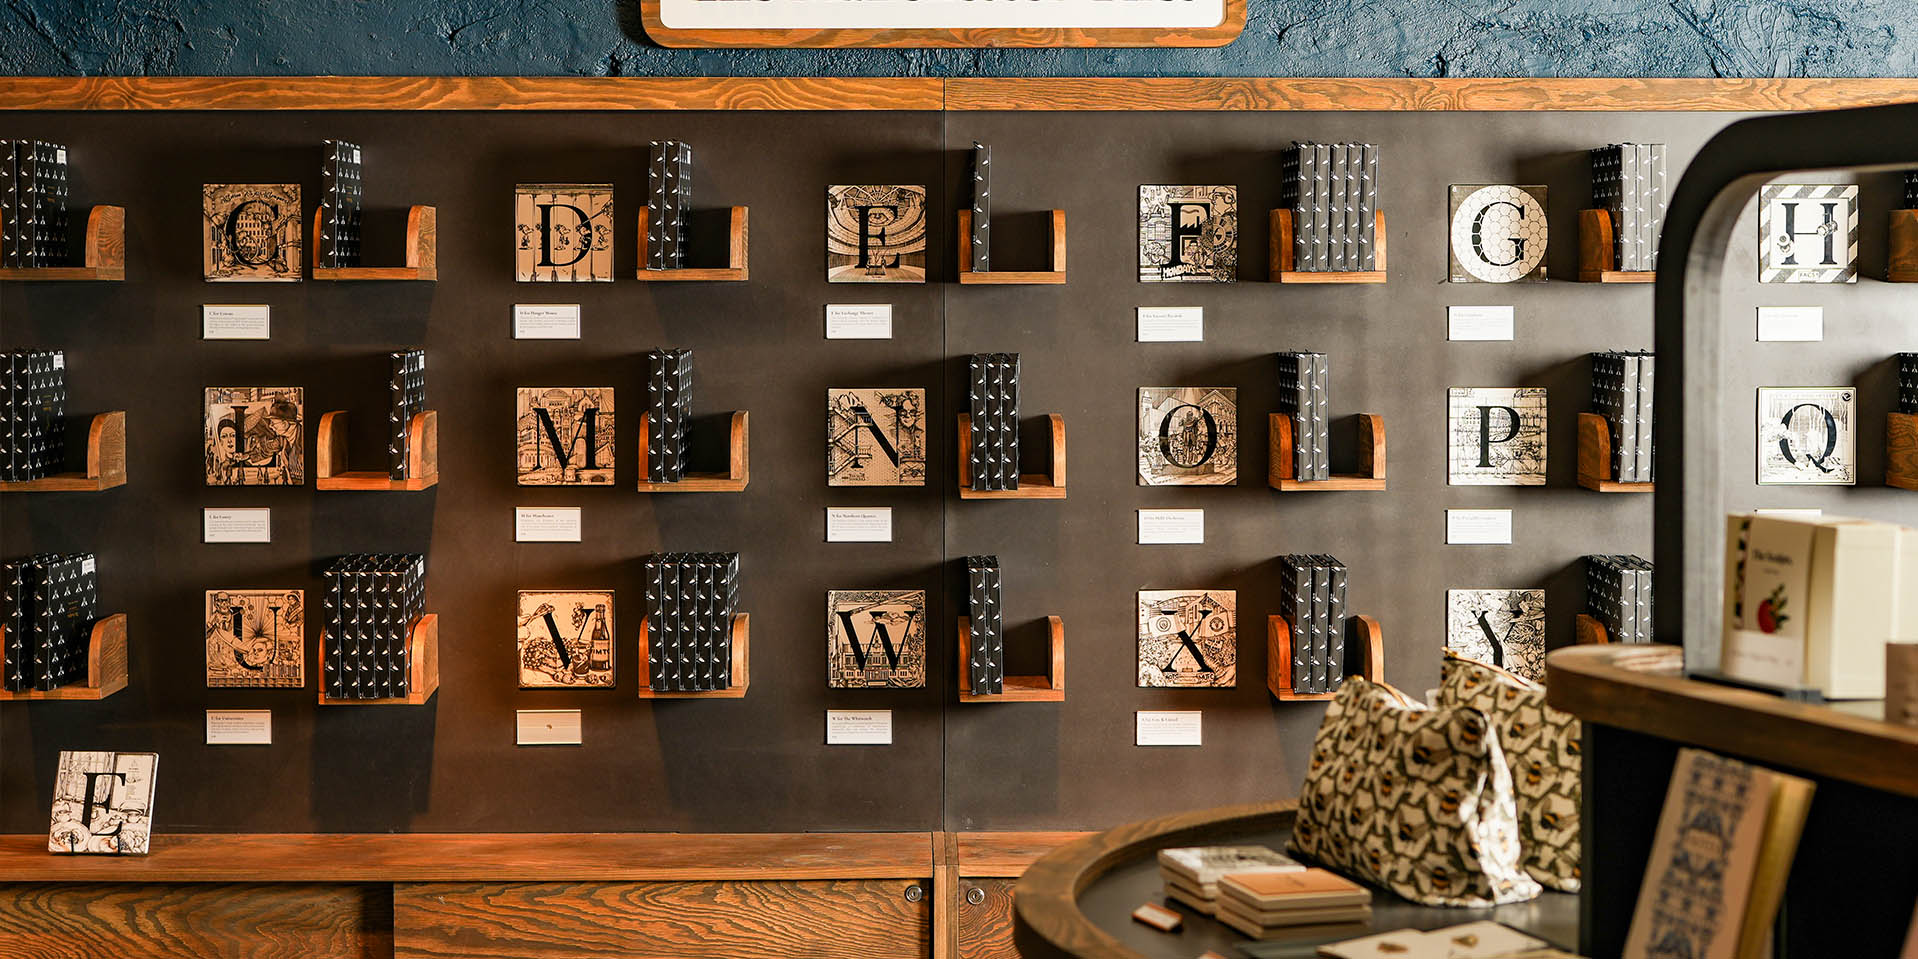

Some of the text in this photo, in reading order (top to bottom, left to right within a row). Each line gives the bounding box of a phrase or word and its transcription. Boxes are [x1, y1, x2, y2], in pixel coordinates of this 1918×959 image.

[225, 199, 281, 266] C
[536, 204, 594, 267] D
[857, 205, 901, 269] E
[1164, 201, 1211, 267] F
[1472, 201, 1529, 267] G
[1781, 202, 1838, 266] H
[230, 405, 277, 468] L
[533, 407, 600, 471] M
[849, 406, 903, 469] N
[1159, 404, 1218, 469] O
[1476, 405, 1521, 468] P
[1779, 403, 1838, 474] Q
[230, 606, 281, 670] U
[543, 608, 596, 670] V
[836, 611, 918, 674] W
[1160, 610, 1215, 673] X
[1471, 610, 1524, 669] Y
[82, 772, 127, 836] E
